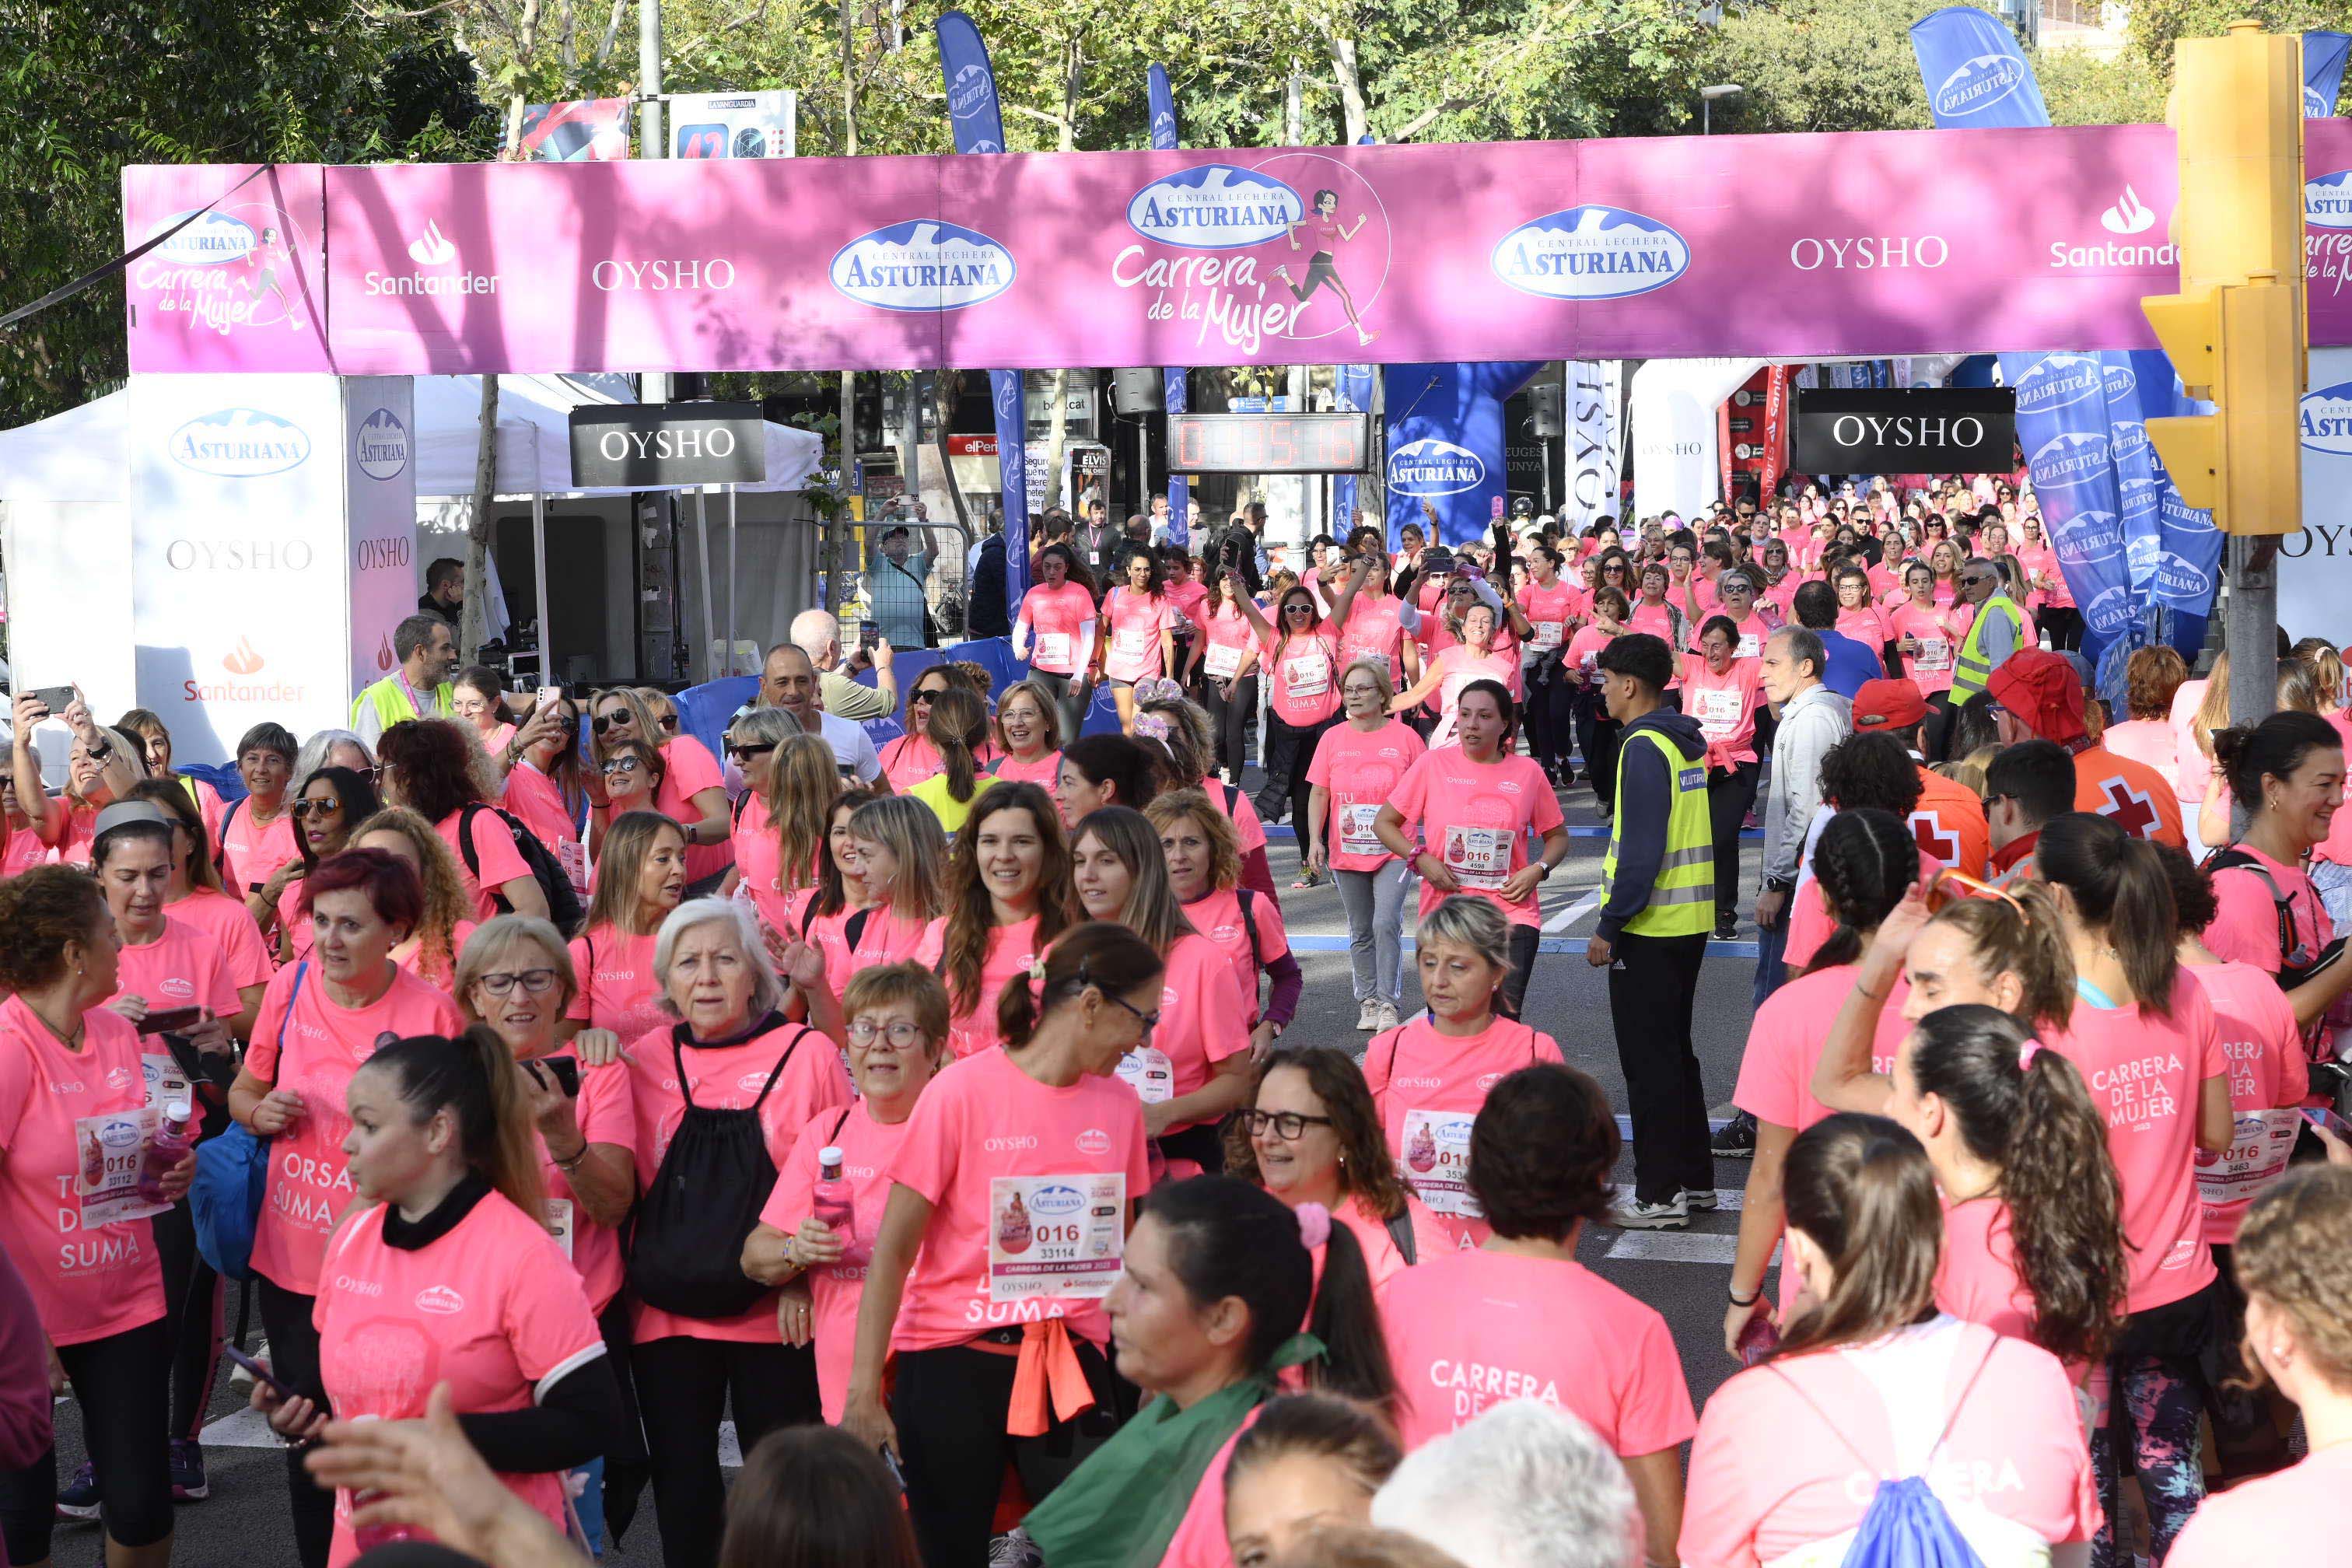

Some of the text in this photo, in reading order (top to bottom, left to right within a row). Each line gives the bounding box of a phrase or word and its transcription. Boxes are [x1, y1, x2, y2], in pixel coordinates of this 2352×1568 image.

[1167, 191, 1285, 202] CENTRAL LECHERA
[1140, 195, 1290, 229] ASTURIANA
[1537, 236, 1668, 248] CENTRAL LECHERA
[872, 248, 996, 261] CENTRAL LECHERA
[1507, 242, 1675, 277] ASTURIANA
[1790, 236, 1948, 271] OYSHO
[136, 261, 229, 290] Carrera
[592, 258, 735, 291] OYSHO
[844, 254, 1002, 288] ASTURIANA
[1111, 244, 1258, 289] Carrera
[2322, 257, 2337, 278] la
[365, 270, 500, 296] Santander
[159, 289, 264, 336] de la Mujer
[1147, 281, 1312, 355] de la Mujer
[1832, 415, 1985, 450] OYSHO
[180, 432, 301, 461] ASTURIANA
[360, 436, 405, 464] ASTURIANA
[600, 427, 736, 461] OYSHO
[1082, 455, 1106, 465] ELVIS
[1390, 462, 1479, 485] ASTURIANA
[166, 539, 313, 572] OYSHO
[358, 536, 410, 571] OYSHO
[1299, 670, 1315, 680] 016
[1914, 670, 1940, 680] SUMA
[184, 679, 305, 702] Santander
[1286, 698, 1318, 709] SUMA
[1447, 776, 1477, 786] OYSHO
[1337, 792, 1354, 804] TU
[222, 842, 249, 853] OYSHO
[1467, 852, 1490, 861] 016
[596, 970, 634, 982] OYSHO
[2091, 1052, 2184, 1091] CARRERA
[1397, 1077, 1441, 1088] OYSHO
[2111, 1077, 2168, 1108] DE LA
[2109, 1096, 2177, 1129] MUJER
[984, 1135, 1038, 1152] OYSHO
[2224, 1145, 2259, 1161] 016
[106, 1154, 137, 1173] 016
[2228, 1162, 2250, 1173] 3463
[108, 1174, 131, 1187] 33112
[1412, 1181, 1444, 1189] CARRERA
[1445, 1170, 1466, 1180] 353
[273, 1181, 334, 1226] SUMA
[1034, 1197, 1080, 1207] ASTURIANA
[1036, 1223, 1080, 1243] 016
[58, 1234, 141, 1269] SUMA
[1040, 1248, 1076, 1259] 33114
[1005, 1262, 1092, 1274] CARRERA DE LA MUJER
[1002, 1281, 1042, 1293] OYSHO
[964, 1299, 1065, 1323] SUMA
[1430, 1360, 1560, 1405] CARRERA
